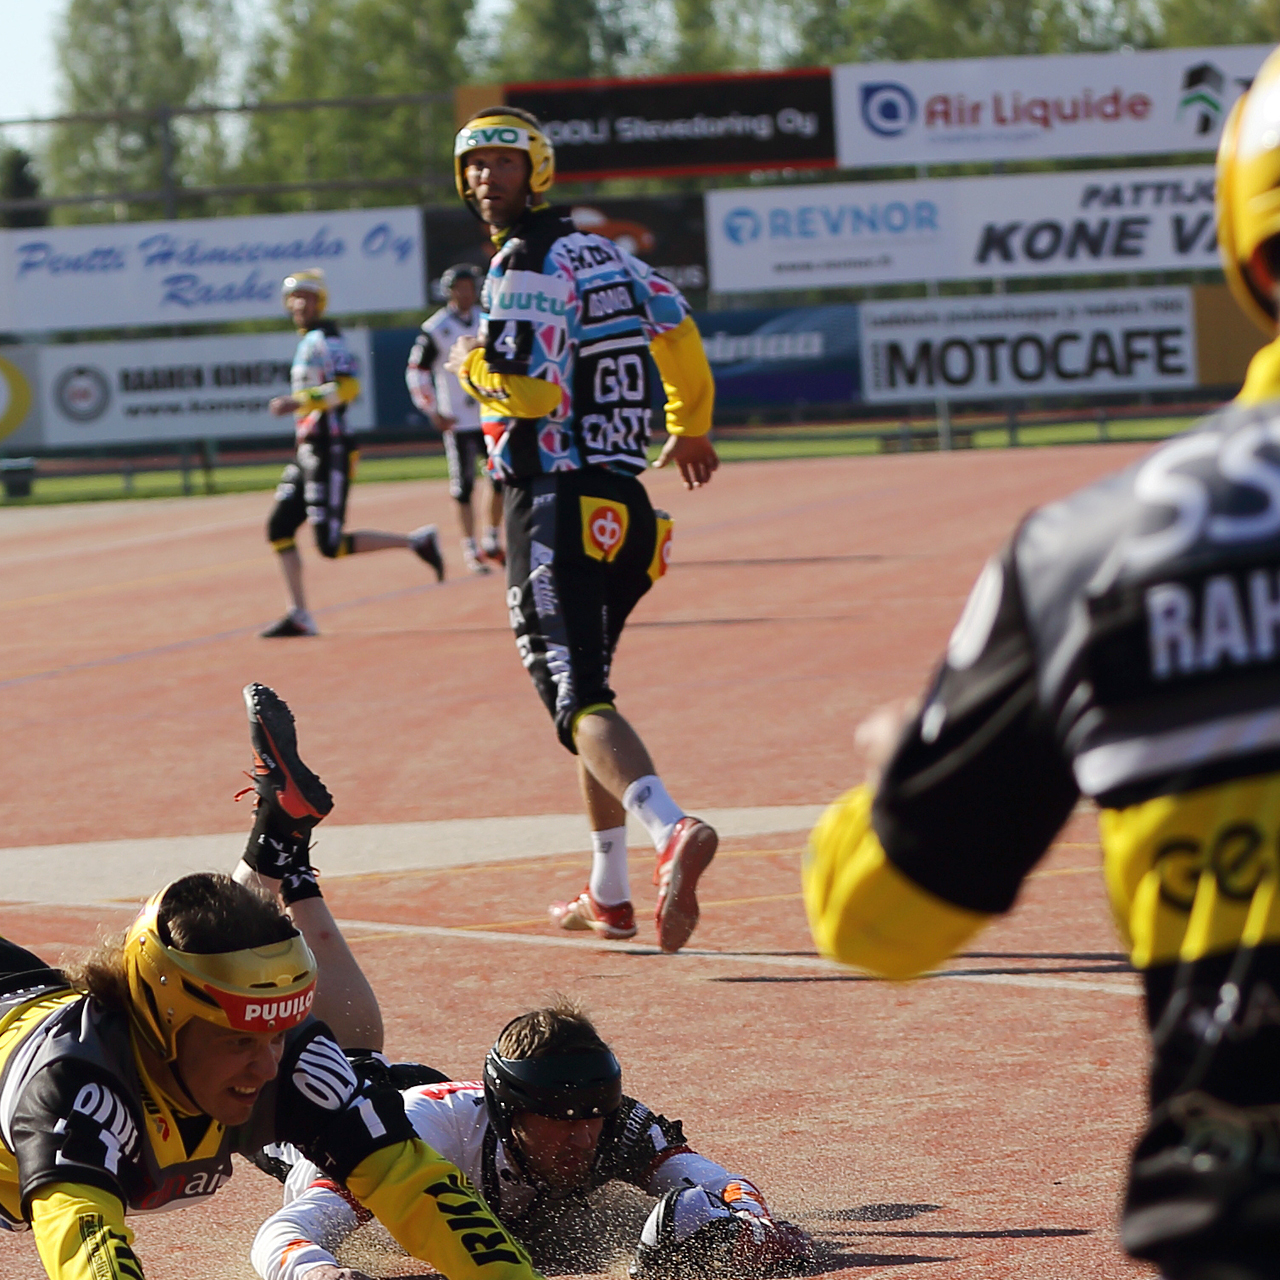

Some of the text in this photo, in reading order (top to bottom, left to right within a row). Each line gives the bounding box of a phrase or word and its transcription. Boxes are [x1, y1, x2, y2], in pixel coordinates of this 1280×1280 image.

[925, 87, 1152, 130] Air Liquide
[769, 200, 938, 238] REVNOR
[975, 214, 1150, 264] KONE
[886, 327, 1188, 389] MOTOCAFE
[244, 989, 315, 1022] PUUILO
